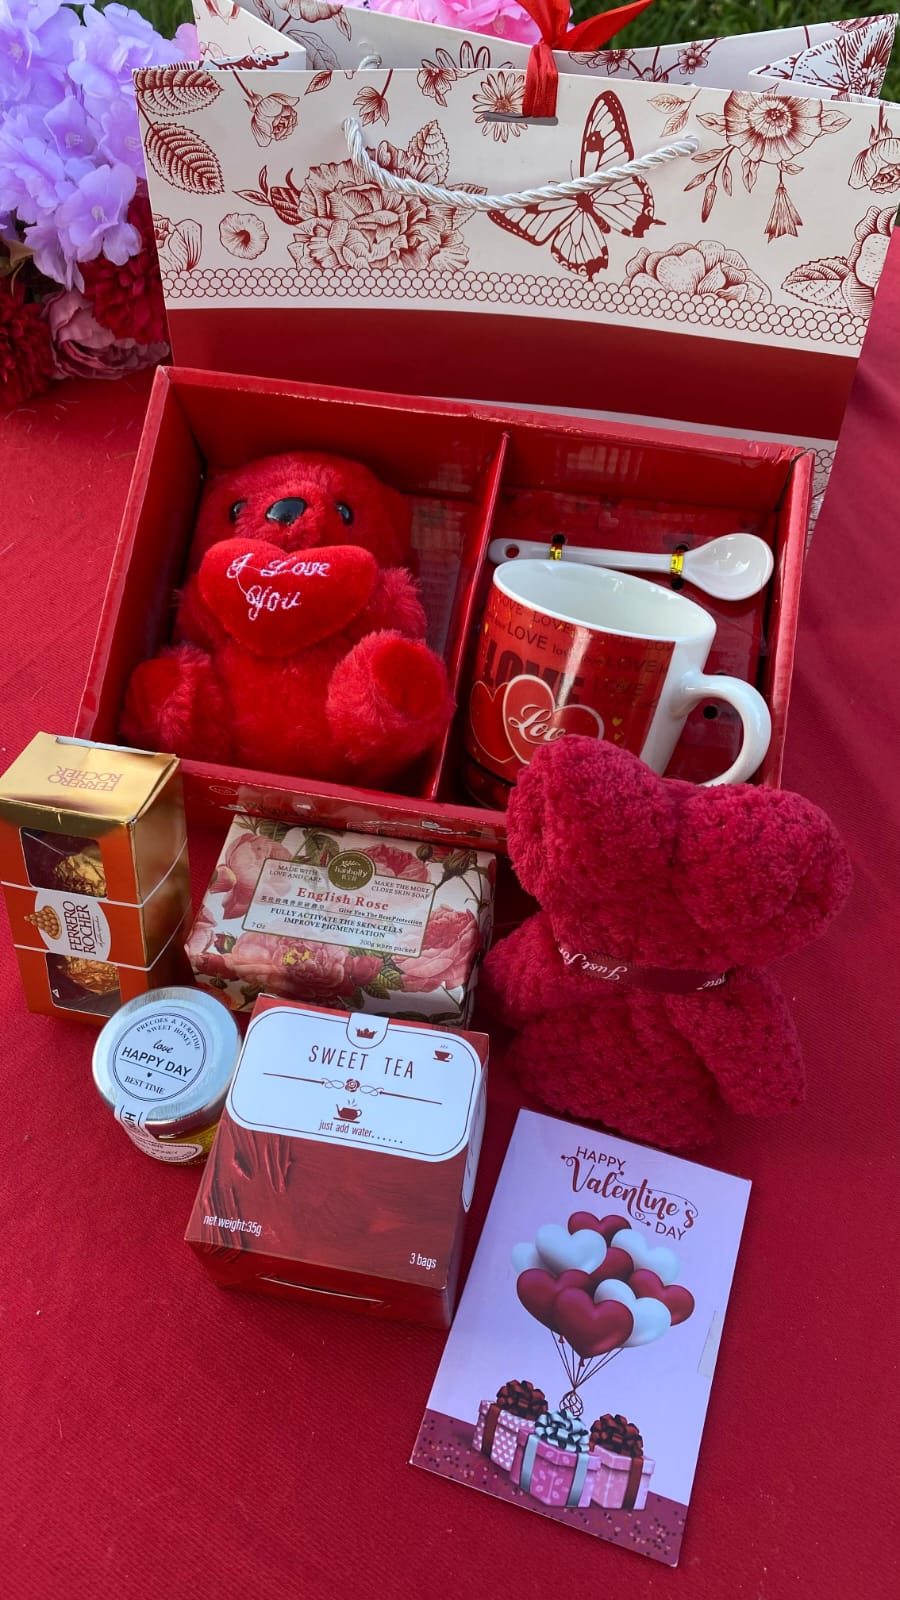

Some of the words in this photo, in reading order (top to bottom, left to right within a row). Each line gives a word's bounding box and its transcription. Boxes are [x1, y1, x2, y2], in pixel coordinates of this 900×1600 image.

[226, 552, 255, 579] I
[260, 556, 331, 577] Love
[245, 585, 302, 621] You
[507, 621, 549, 651] LOVE
[606, 655, 657, 673] LOVE
[508, 703, 566, 746] Lov
[47, 774, 117, 792] FERRERO
[56, 765, 125, 783] ROCHER
[278, 865, 298, 873] MADE
[371, 886, 394, 894] CLOSE
[374, 880, 395, 888] MAKE
[410, 886, 430, 894] MOST
[296, 887, 350, 906] English
[354, 896, 389, 911] Rose
[62, 900, 83, 952] FERRERO
[76, 904, 97, 955] ROCHER
[270, 907, 298, 917] FULLY
[297, 912, 338, 924] ACTIVATE
[339, 918, 356, 926] THE
[356, 920, 376, 929] SKIN
[376, 923, 405, 934] CELLS
[283, 917, 321, 928] IMPROVE
[321, 923, 386, 938] PIGMENTATION
[391, 916, 423, 926] Protection
[359, 939, 376, 948] 200g
[393, 946, 417, 954] packed
[582, 964, 628, 981] Just
[153, 1040, 174, 1054] love
[121, 1046, 165, 1068] HAPPY
[165, 1061, 192, 1077] DAY
[308, 1045, 369, 1071] SWEET
[384, 1056, 414, 1080] TEA
[124, 1075, 144, 1088] BEST
[144, 1082, 166, 1096] TIME
[318, 1120, 334, 1131] just
[335, 1123, 350, 1134] add
[576, 1146, 626, 1171] HAPPY
[561, 1155, 699, 1229] Valentine's
[203, 1215, 218, 1226] net
[655, 1221, 686, 1241] DAY
[410, 1252, 416, 1265] 3
[416, 1252, 437, 1270] bags
